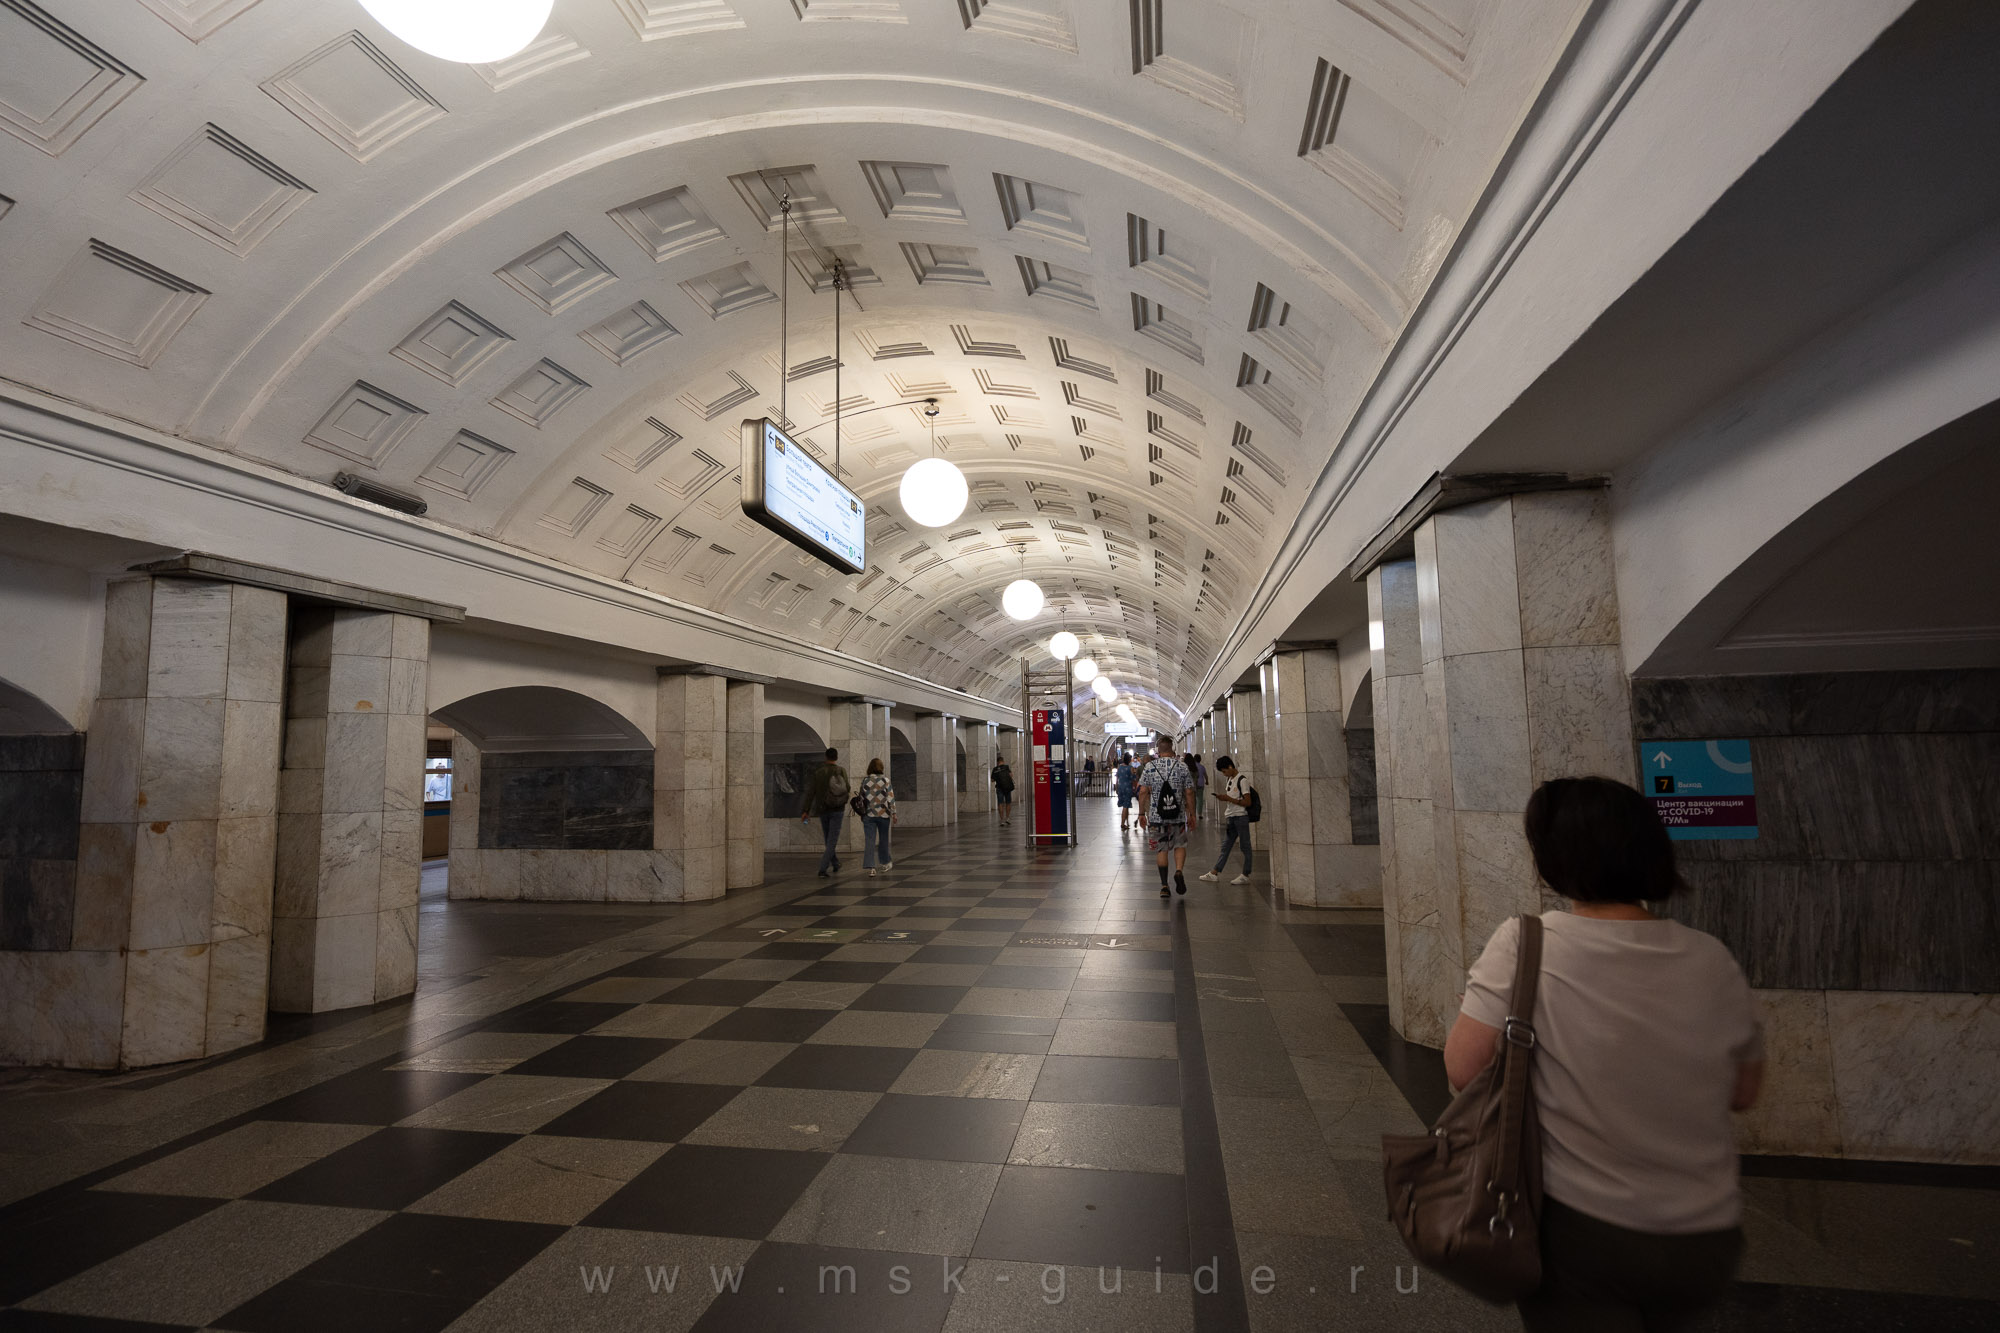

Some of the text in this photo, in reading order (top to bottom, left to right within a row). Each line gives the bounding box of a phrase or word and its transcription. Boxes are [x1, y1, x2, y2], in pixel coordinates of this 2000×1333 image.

[1660, 779, 1669, 790] 7
[1677, 781, 1703, 789] Выход
[1656, 800, 1686, 808] Центр
[1669, 807, 1714, 816] COVID-19
